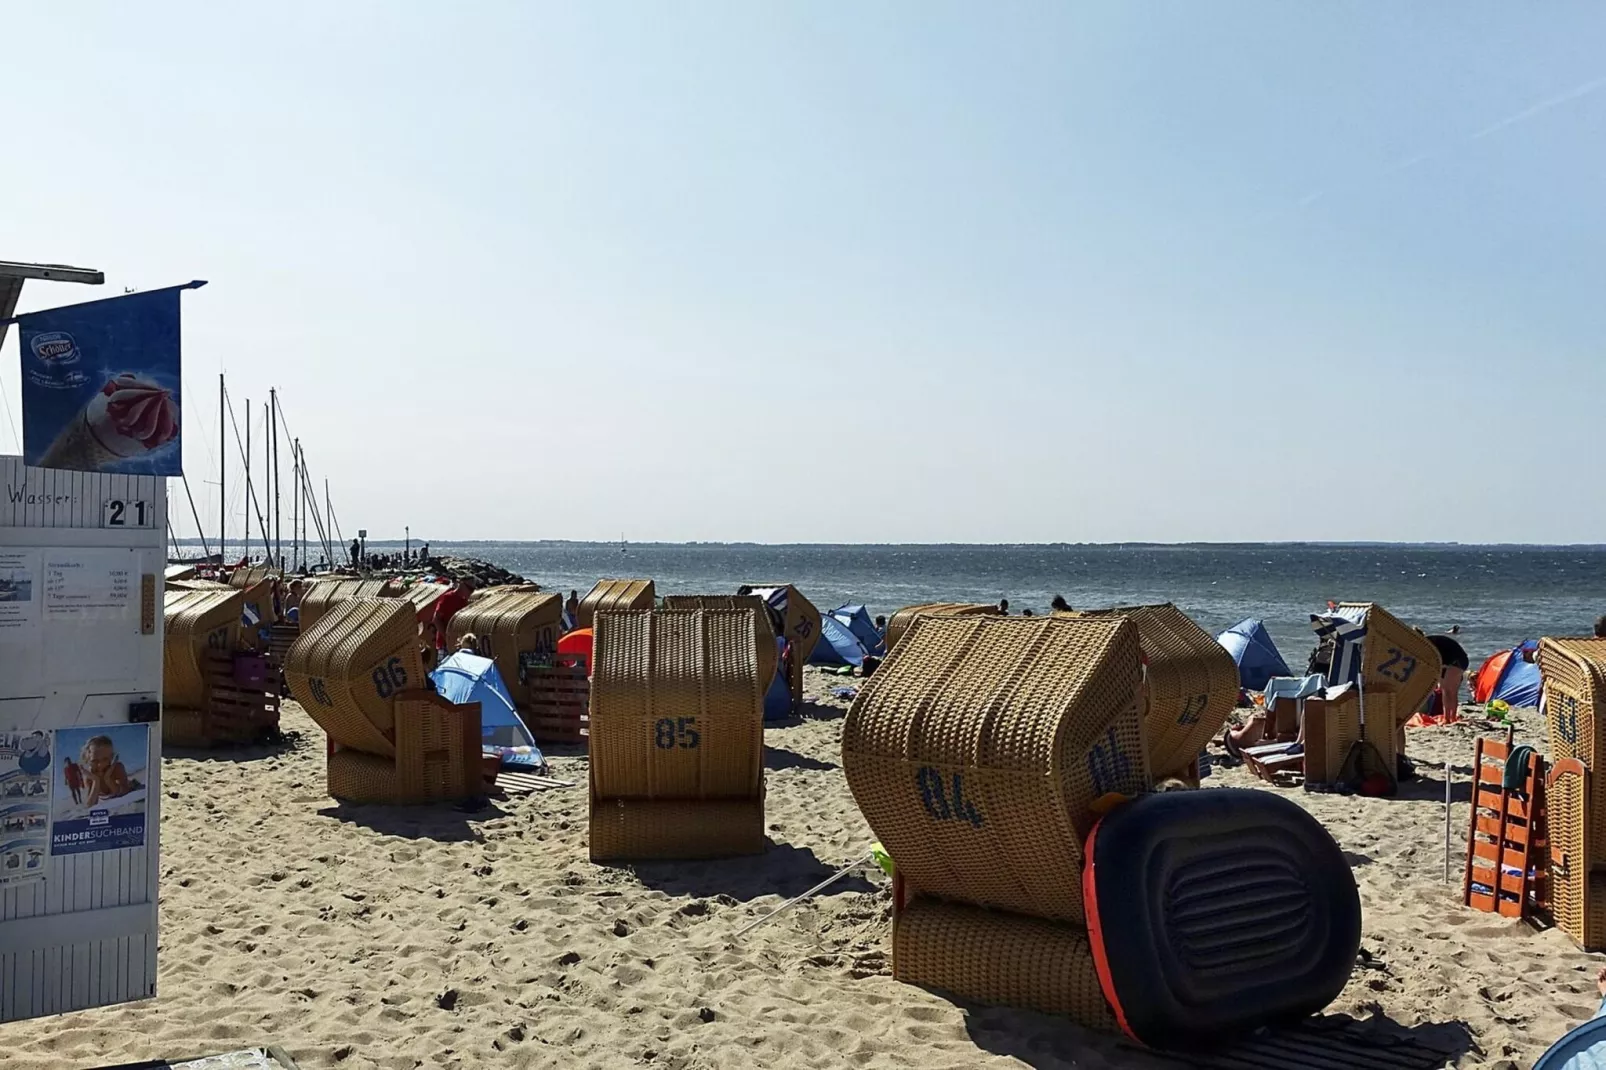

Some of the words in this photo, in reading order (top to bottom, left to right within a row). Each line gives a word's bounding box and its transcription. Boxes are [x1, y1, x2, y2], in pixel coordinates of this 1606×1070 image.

[8, 483, 77, 504] Wasser:
[371, 657, 407, 698] 86
[1377, 647, 1416, 682] 23
[655, 717, 699, 749] 85
[53, 826, 143, 842] KINDERSUCHBAND
